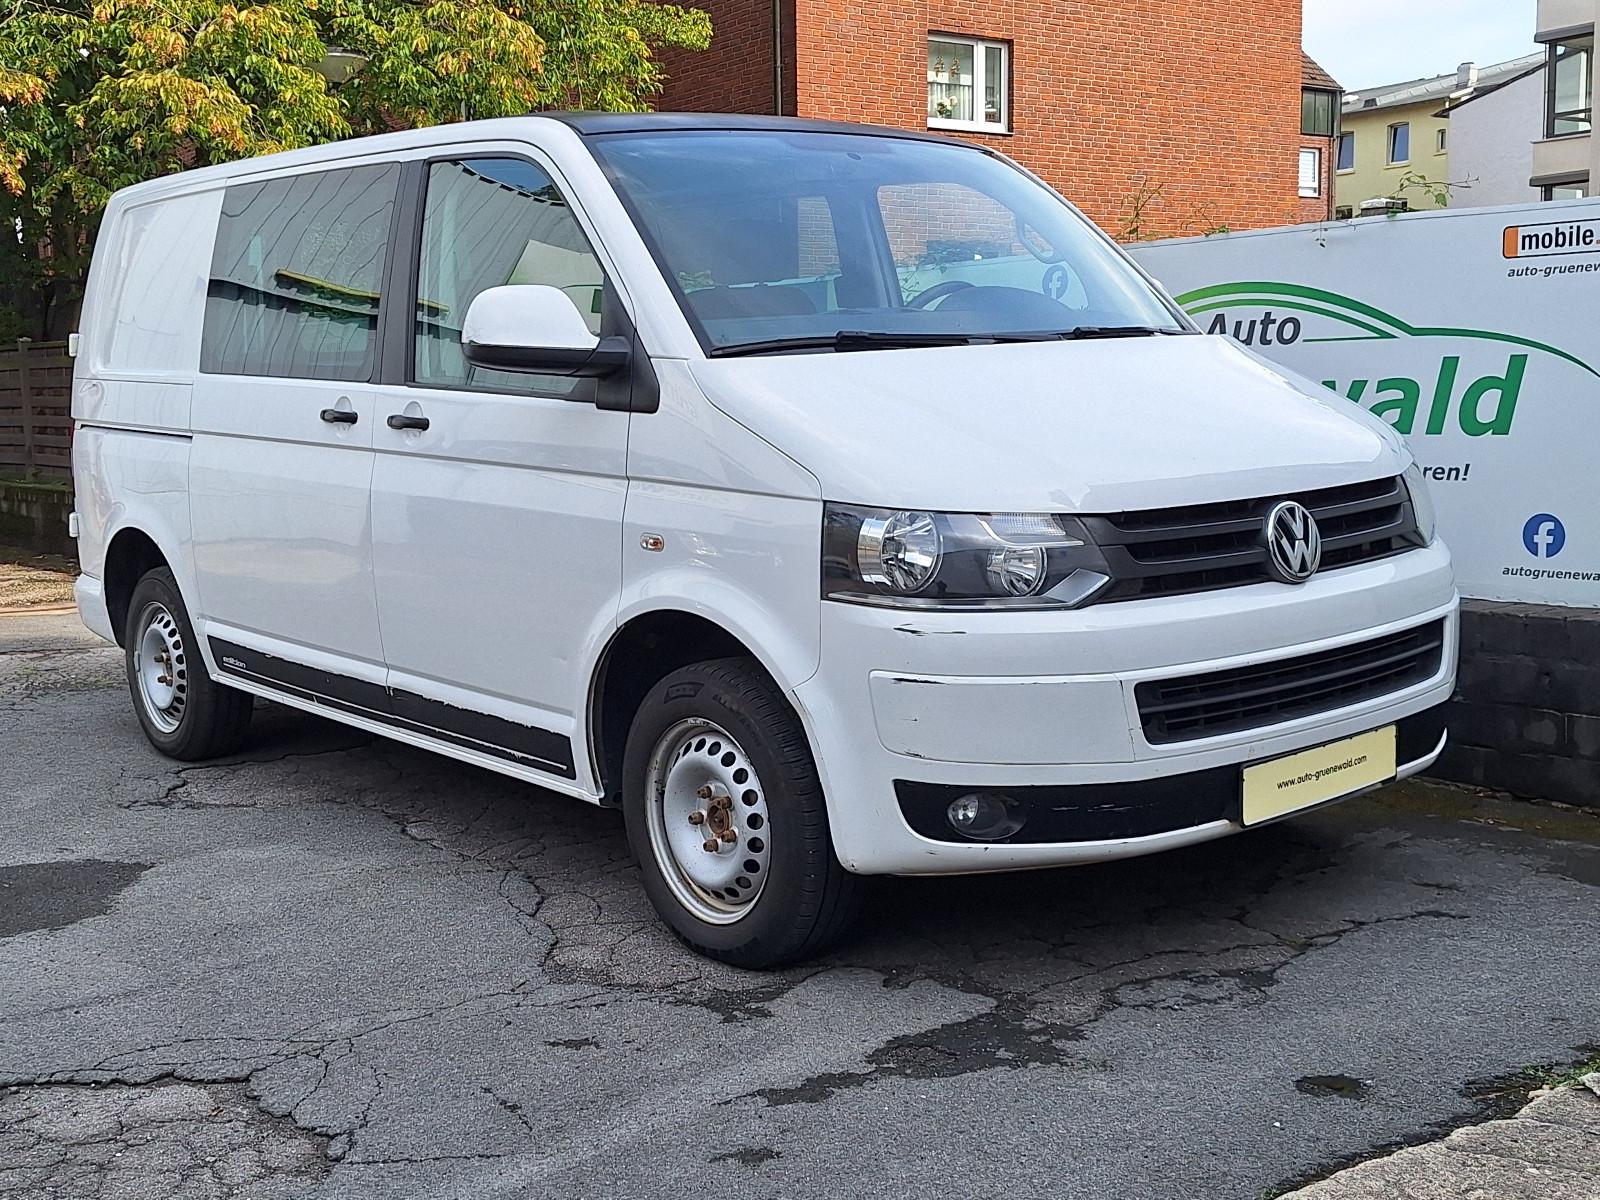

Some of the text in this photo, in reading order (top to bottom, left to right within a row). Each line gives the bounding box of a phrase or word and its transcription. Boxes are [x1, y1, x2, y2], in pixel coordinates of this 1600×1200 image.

[1207, 311, 1301, 346] Auto
[1272, 505, 1319, 575] VW
[1276, 754, 1367, 789] www.auto-gruenewald.com
